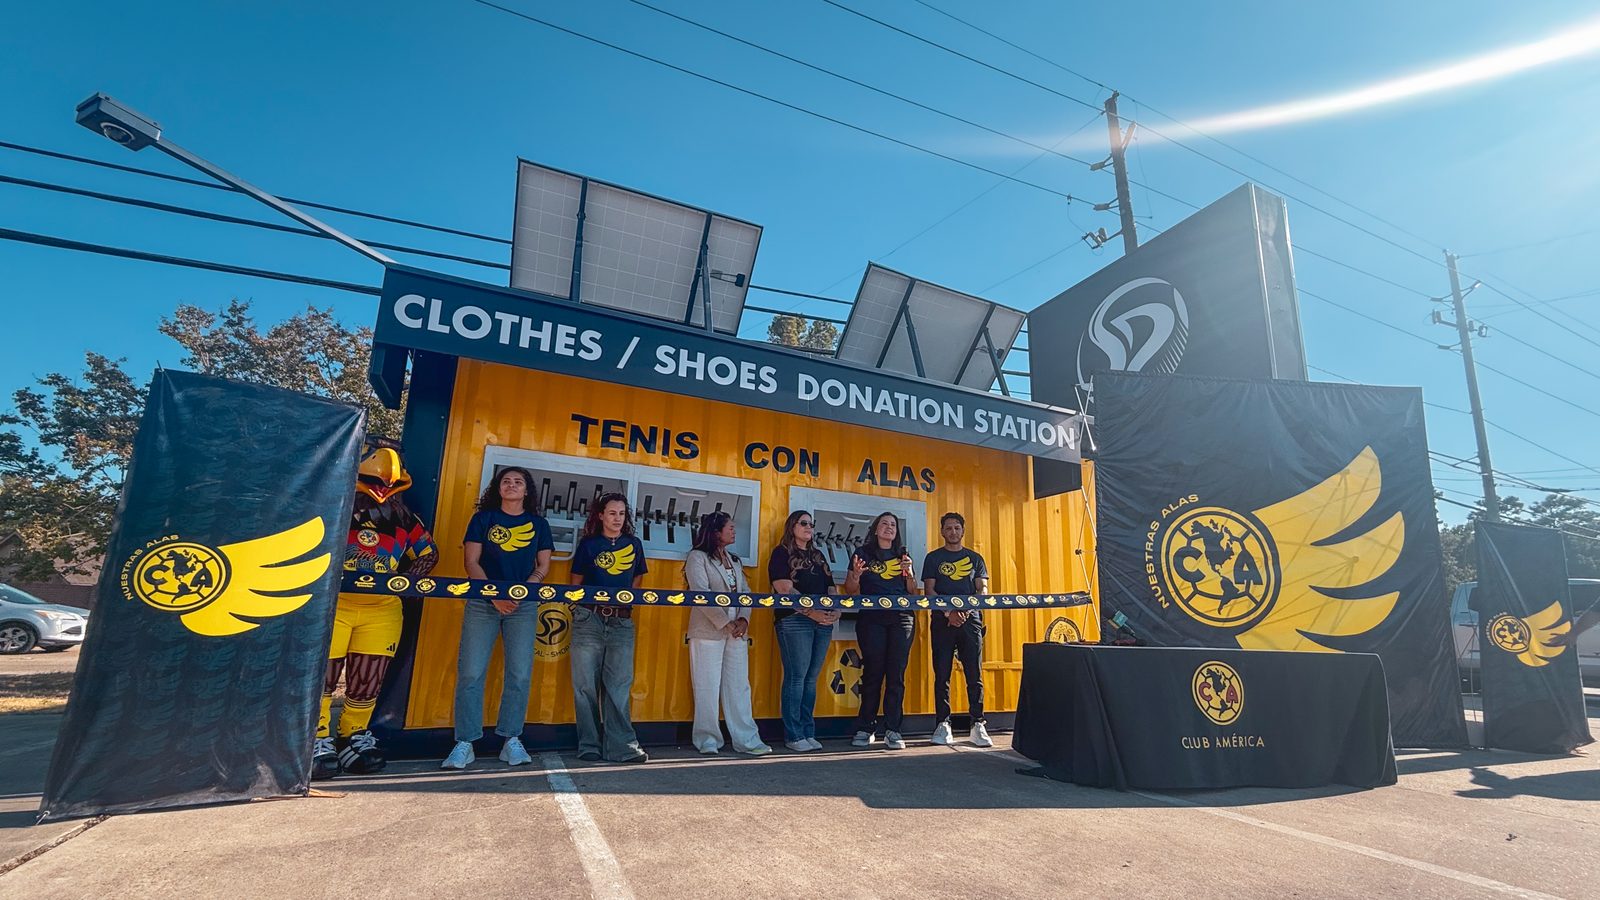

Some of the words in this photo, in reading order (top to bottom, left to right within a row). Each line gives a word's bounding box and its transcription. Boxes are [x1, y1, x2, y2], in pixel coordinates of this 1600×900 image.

[393, 294, 603, 361] CLOTHES
[616, 336, 640, 369] /
[653, 345, 778, 394] SHOES
[797, 373, 964, 428] DONATION
[973, 408, 1076, 450] STATION
[570, 413, 700, 460] TENIS
[743, 442, 820, 478] CON
[857, 458, 936, 493] ALAS
[120, 549, 143, 601] NUESTRAS
[146, 534, 179, 549] ALAS
[1143, 520, 1170, 609] NUESTRAS
[1161, 493, 1199, 519] ALAS
[1181, 736, 1210, 749] CLUB
[1216, 733, 1265, 748] AMÉRICA
